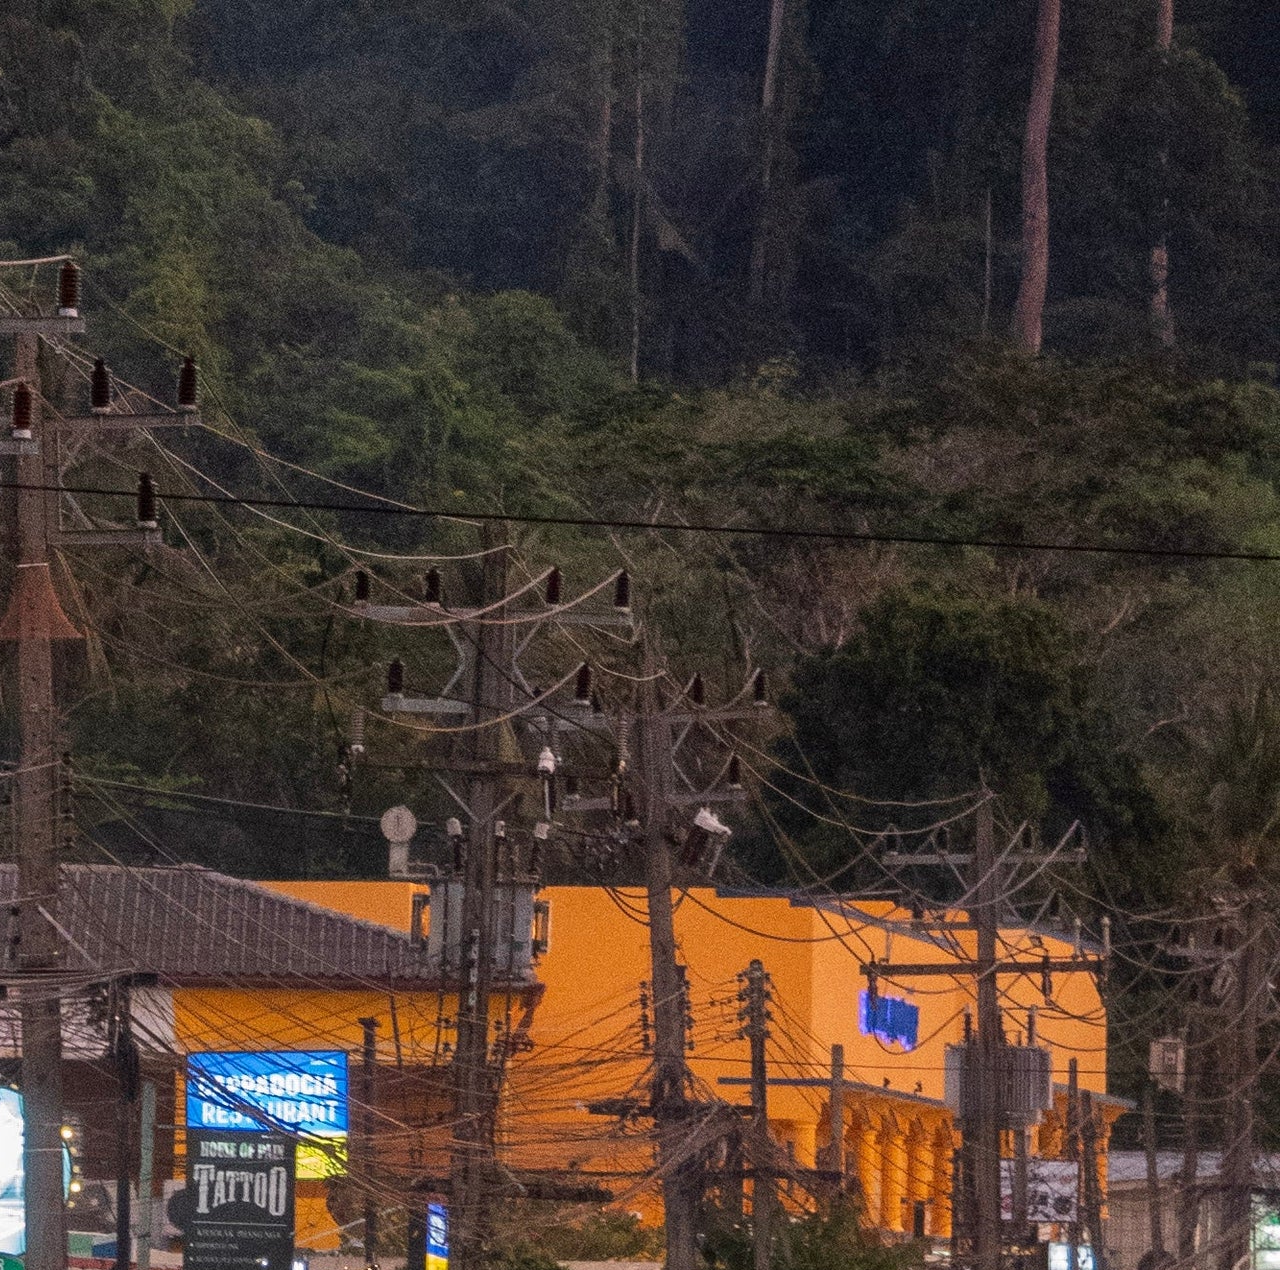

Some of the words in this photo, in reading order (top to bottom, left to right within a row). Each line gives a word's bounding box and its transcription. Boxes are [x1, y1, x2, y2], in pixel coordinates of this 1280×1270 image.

[202, 1100, 339, 1125] RESURANT
[200, 1141, 237, 1158] HOUSE
[239, 1142, 255, 1159] OF
[257, 1144, 286, 1160] PAIN
